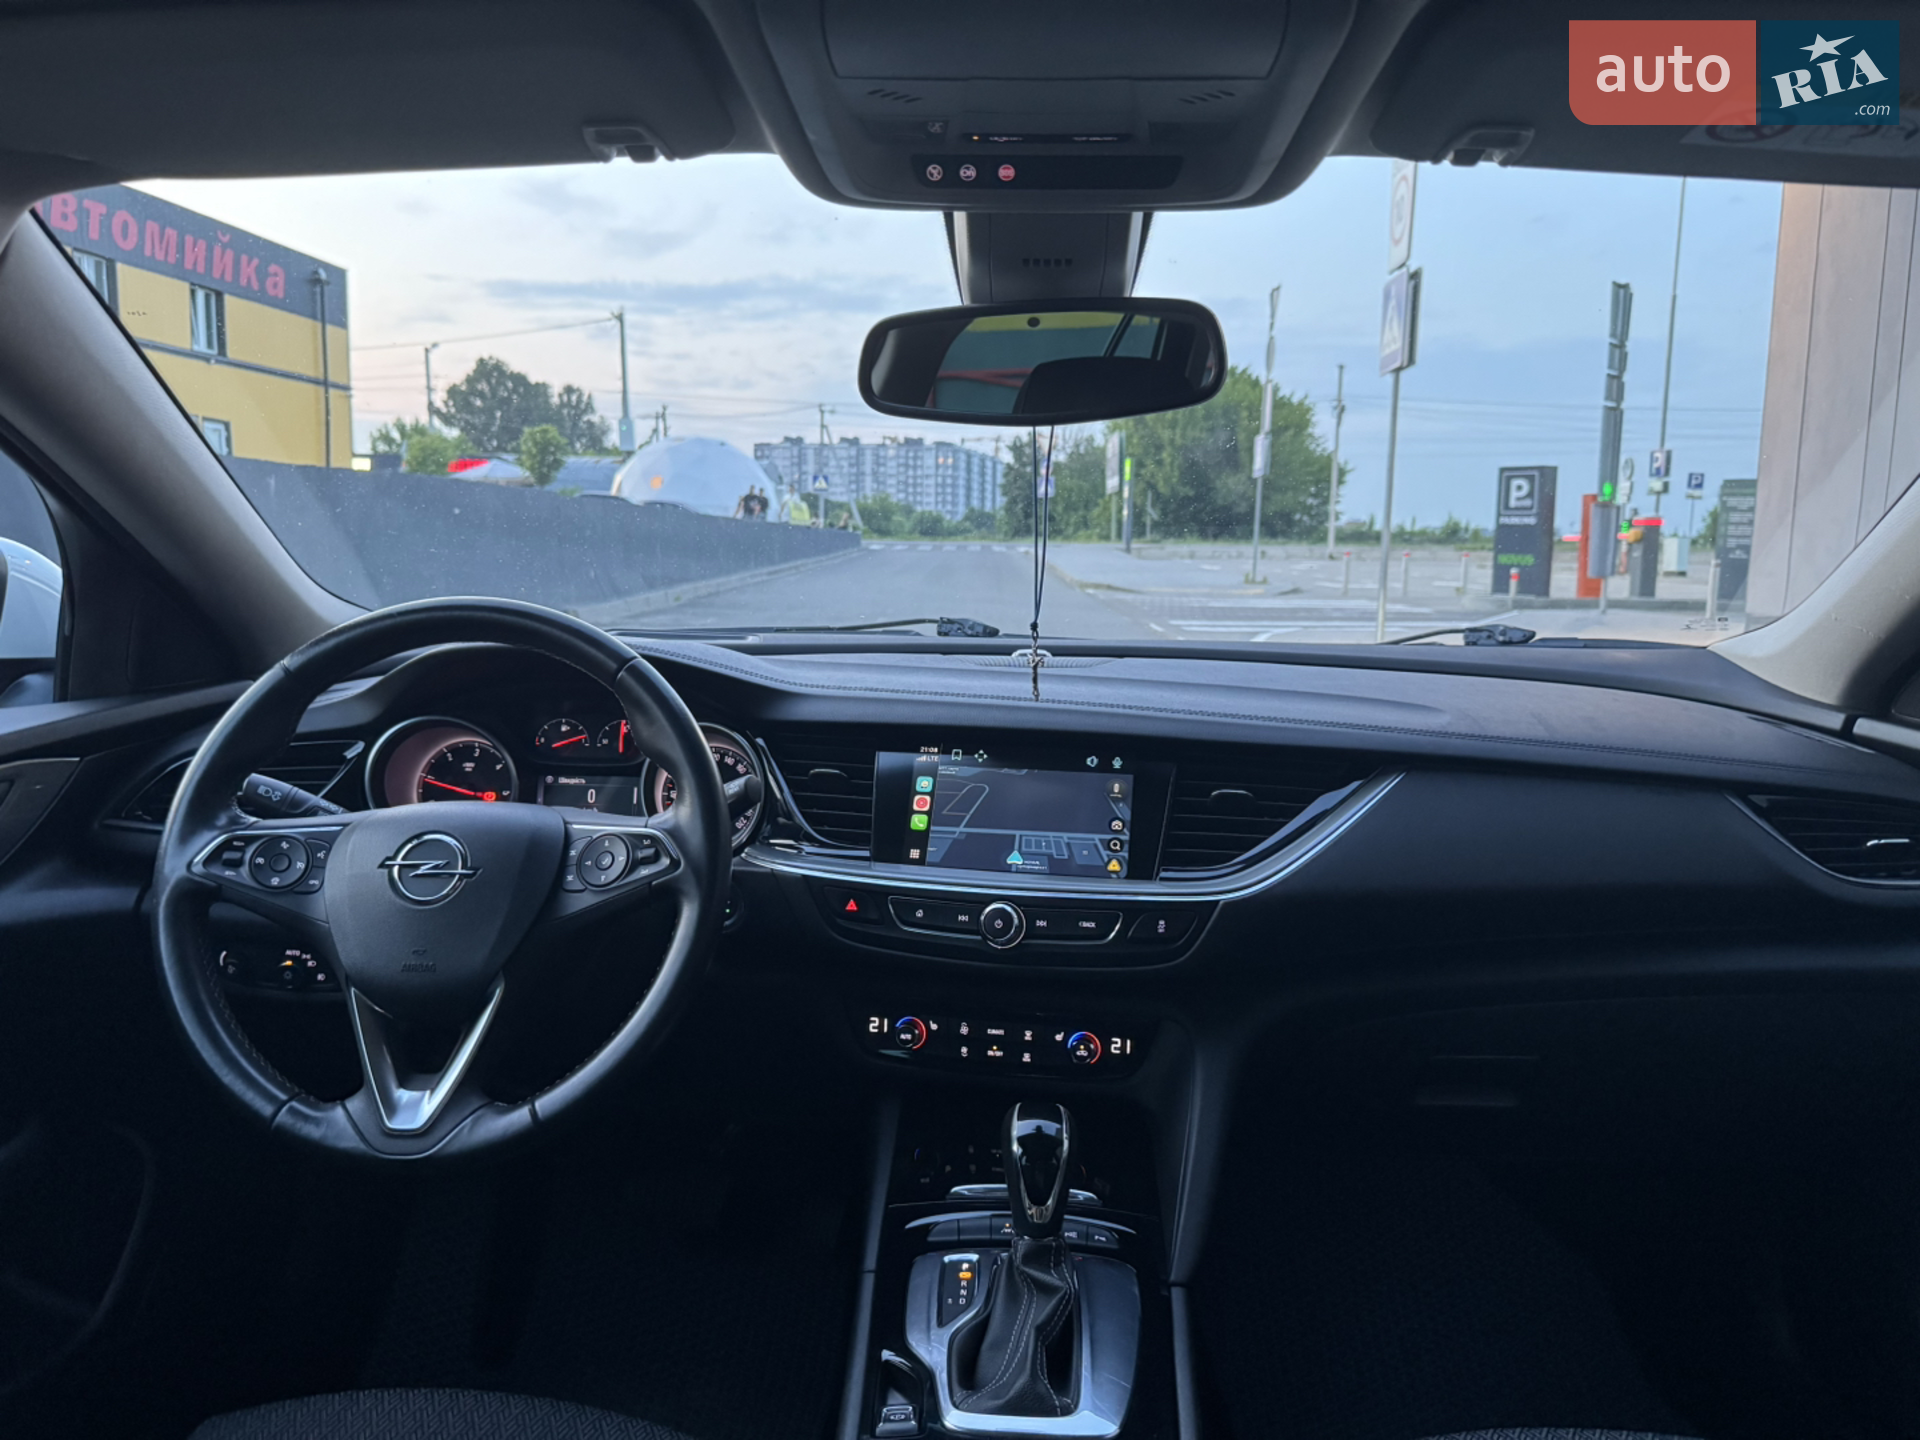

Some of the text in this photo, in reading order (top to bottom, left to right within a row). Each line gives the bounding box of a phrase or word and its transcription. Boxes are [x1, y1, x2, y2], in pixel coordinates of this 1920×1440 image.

[1691, 475, 1702, 488] P
[587, 788, 596, 804] 0
[400, 961, 437, 973] AIRBAG
[868, 1016, 888, 1033] 21
[1110, 1037, 1131, 1054] 21
[960, 1279, 968, 1288] R
[959, 1288, 968, 1296] N
[959, 1297, 966, 1305] D
